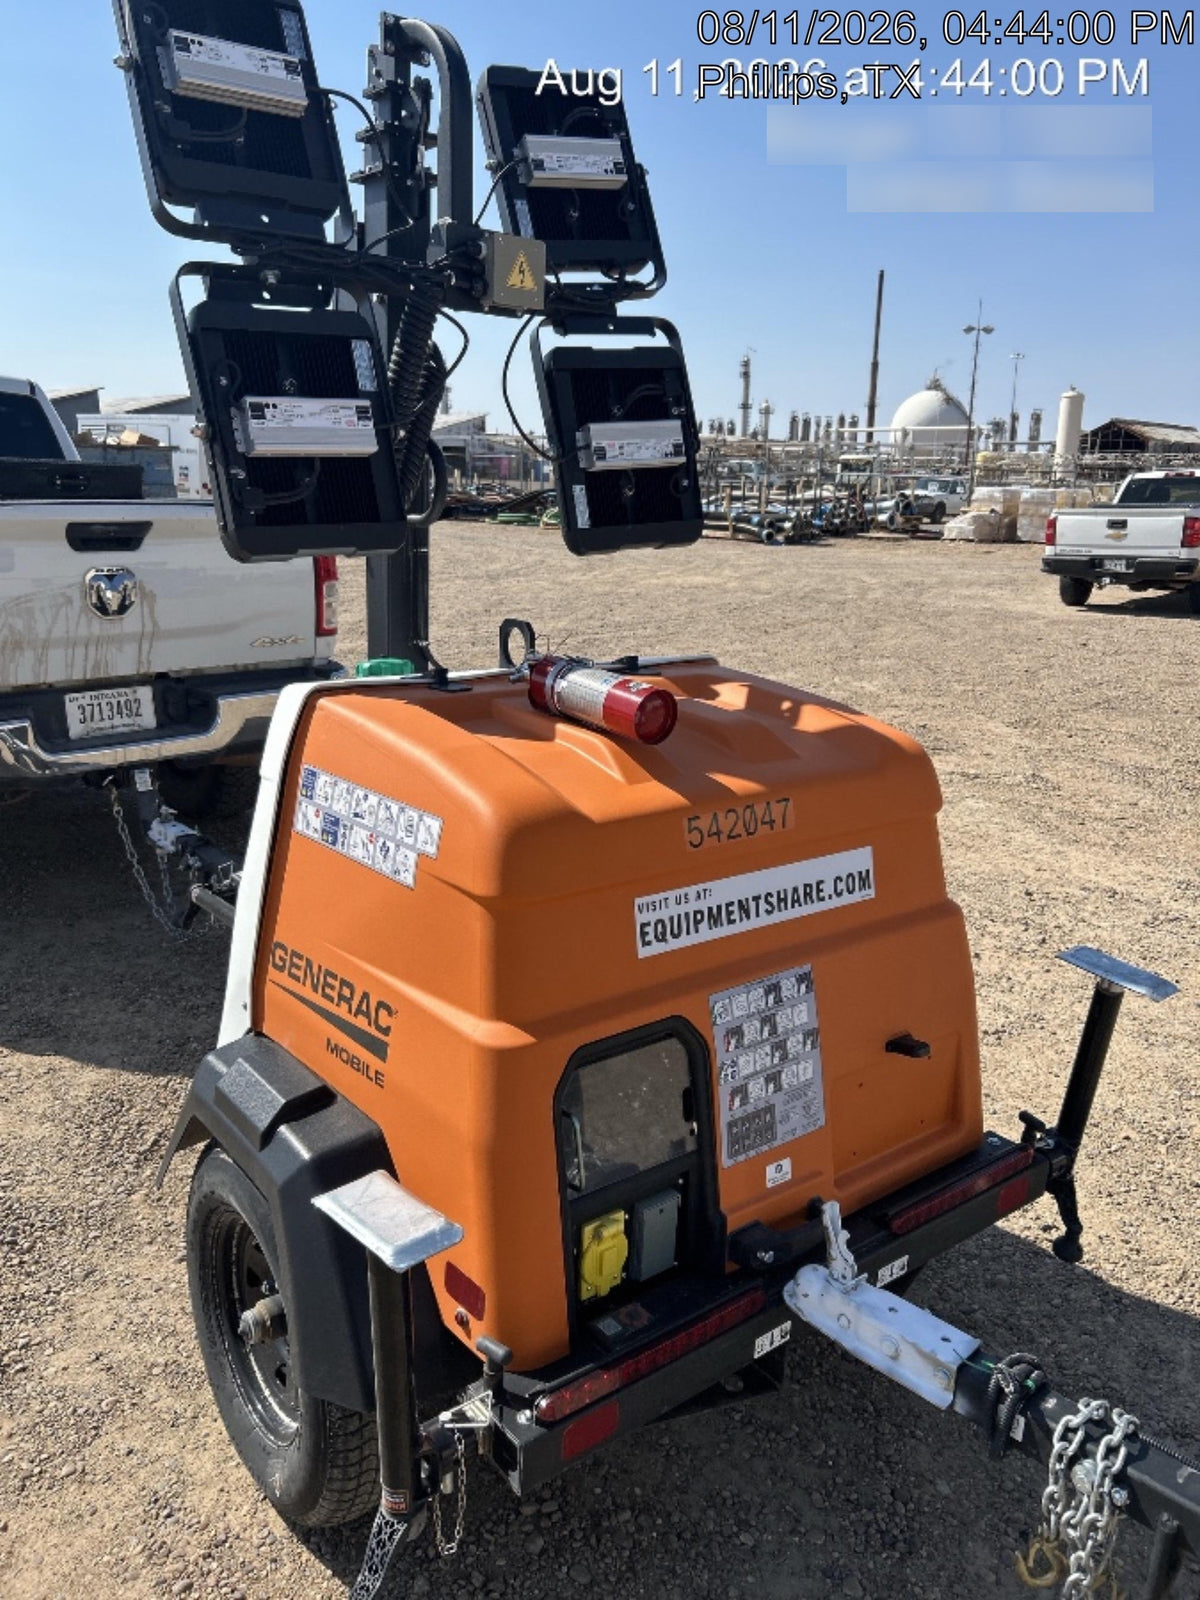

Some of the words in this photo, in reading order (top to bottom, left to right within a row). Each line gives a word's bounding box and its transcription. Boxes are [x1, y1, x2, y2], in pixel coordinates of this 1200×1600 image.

[77, 698, 143, 725] 3713492
[686, 797, 791, 848] 542047
[637, 897, 669, 914] VISIT
[675, 892, 690, 905] US
[695, 888, 712, 901] AT:
[639, 868, 872, 948] EQUIPMENTSHARE.COM
[269, 940, 393, 1037] GENERAC
[326, 1037, 385, 1089] MOBILE
